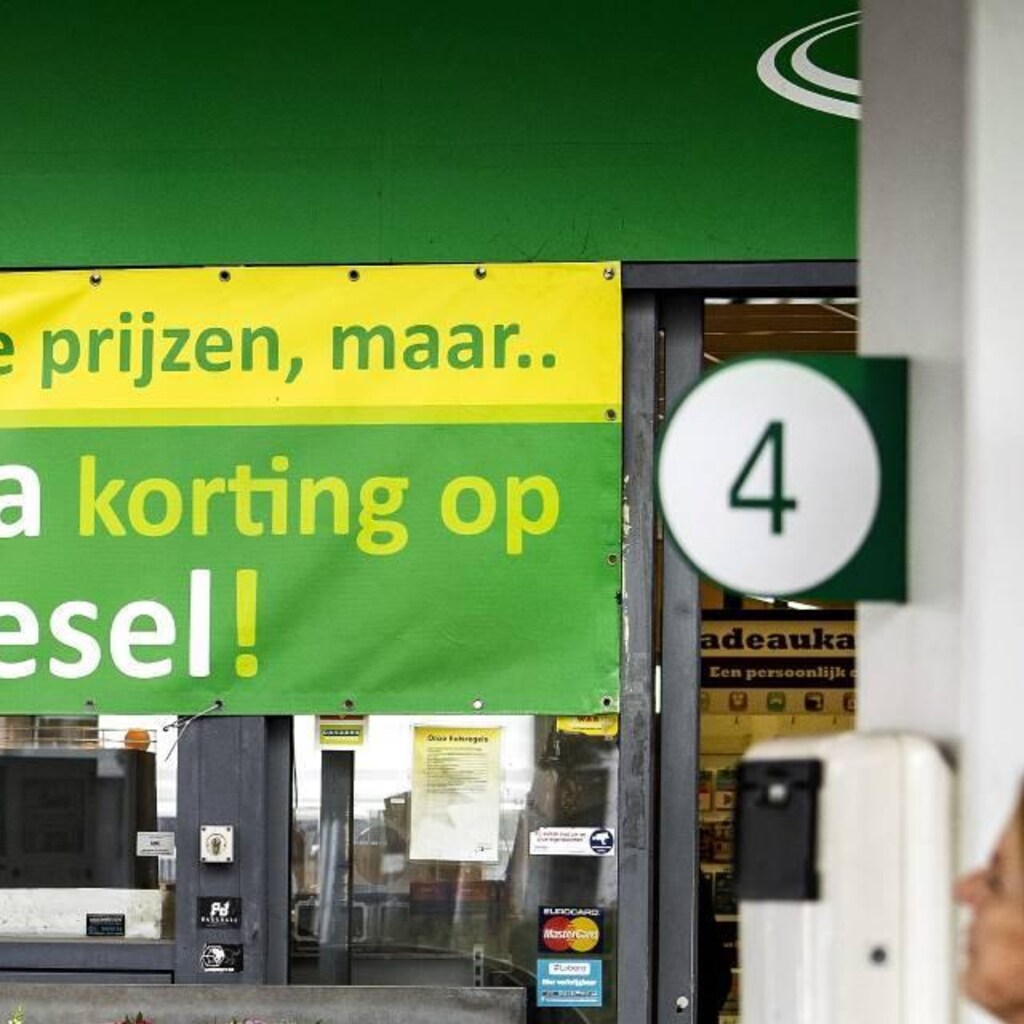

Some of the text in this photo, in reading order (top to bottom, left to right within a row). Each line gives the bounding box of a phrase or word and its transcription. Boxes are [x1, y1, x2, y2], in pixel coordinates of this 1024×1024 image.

[41, 311, 304, 389] prijzen,
[332, 322, 558, 373] maar..
[79, 454, 409, 556] korting
[440, 475, 561, 555] op
[730, 419, 797, 535] 4
[709, 666, 742, 678] Een
[746, 666, 846, 681] persoonlijk
